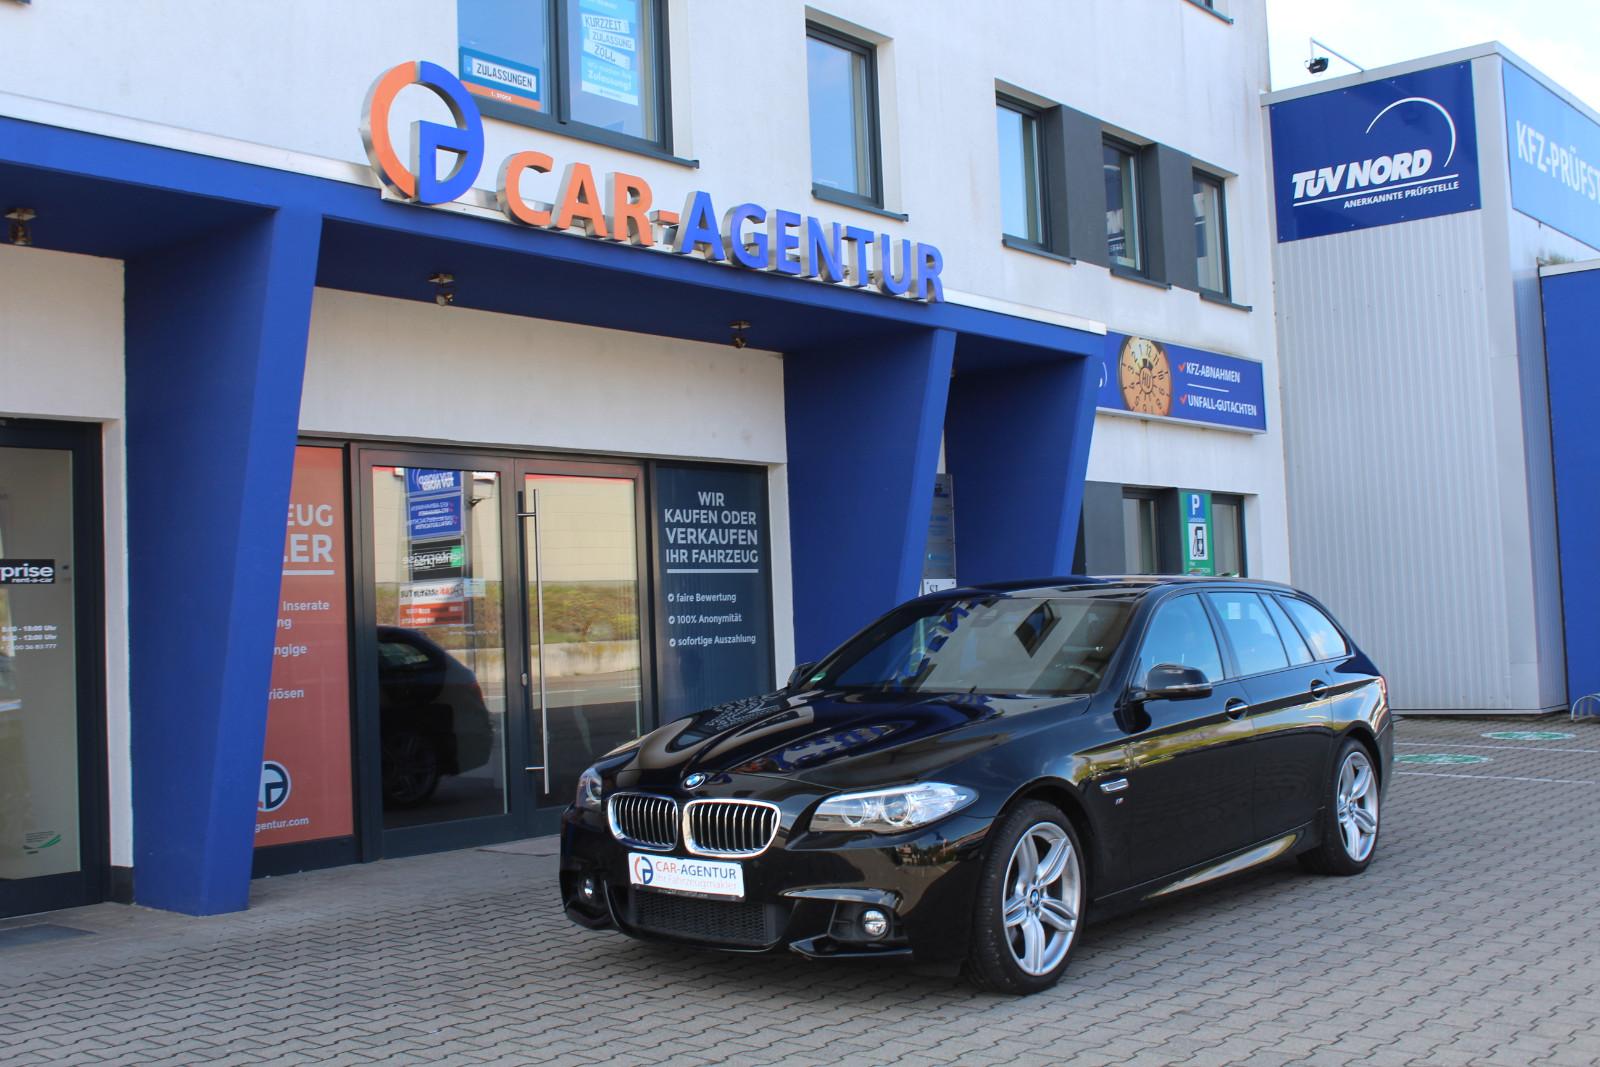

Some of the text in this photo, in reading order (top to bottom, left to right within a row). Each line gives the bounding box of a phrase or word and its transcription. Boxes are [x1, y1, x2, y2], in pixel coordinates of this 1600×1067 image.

[585, 16, 622, 31] KURZZEIT
[592, 31, 632, 48] ZULASSUNG
[476, 63, 533, 88] ZULASSUNGEN
[1346, 149, 1432, 190] NORD
[1344, 181, 1460, 208] ANERKANNTE PRÜFSTELLE
[499, 150, 945, 303] CAR-AGENTUR
[1186, 362, 1241, 383] KFZ-ABNAHMEN
[1188, 394, 1257, 416] UNFALL-GUTACHTEN
[698, 491, 725, 507] WIR
[1191, 494, 1200, 515] P
[664, 509, 757, 525] KAUFEN ODER
[665, 528, 758, 545] VERKAUFEN
[283, 534, 334, 562] ER
[666, 549, 759, 563] IHR FAHRZEUG
[283, 601, 330, 611] Inserate
[676, 593, 737, 603] faire Bewertung
[677, 613, 742, 625] 100% Anonymität
[678, 634, 756, 646] sofortige Auszahlung
[656, 861, 737, 879] CAR-AGENTUR
